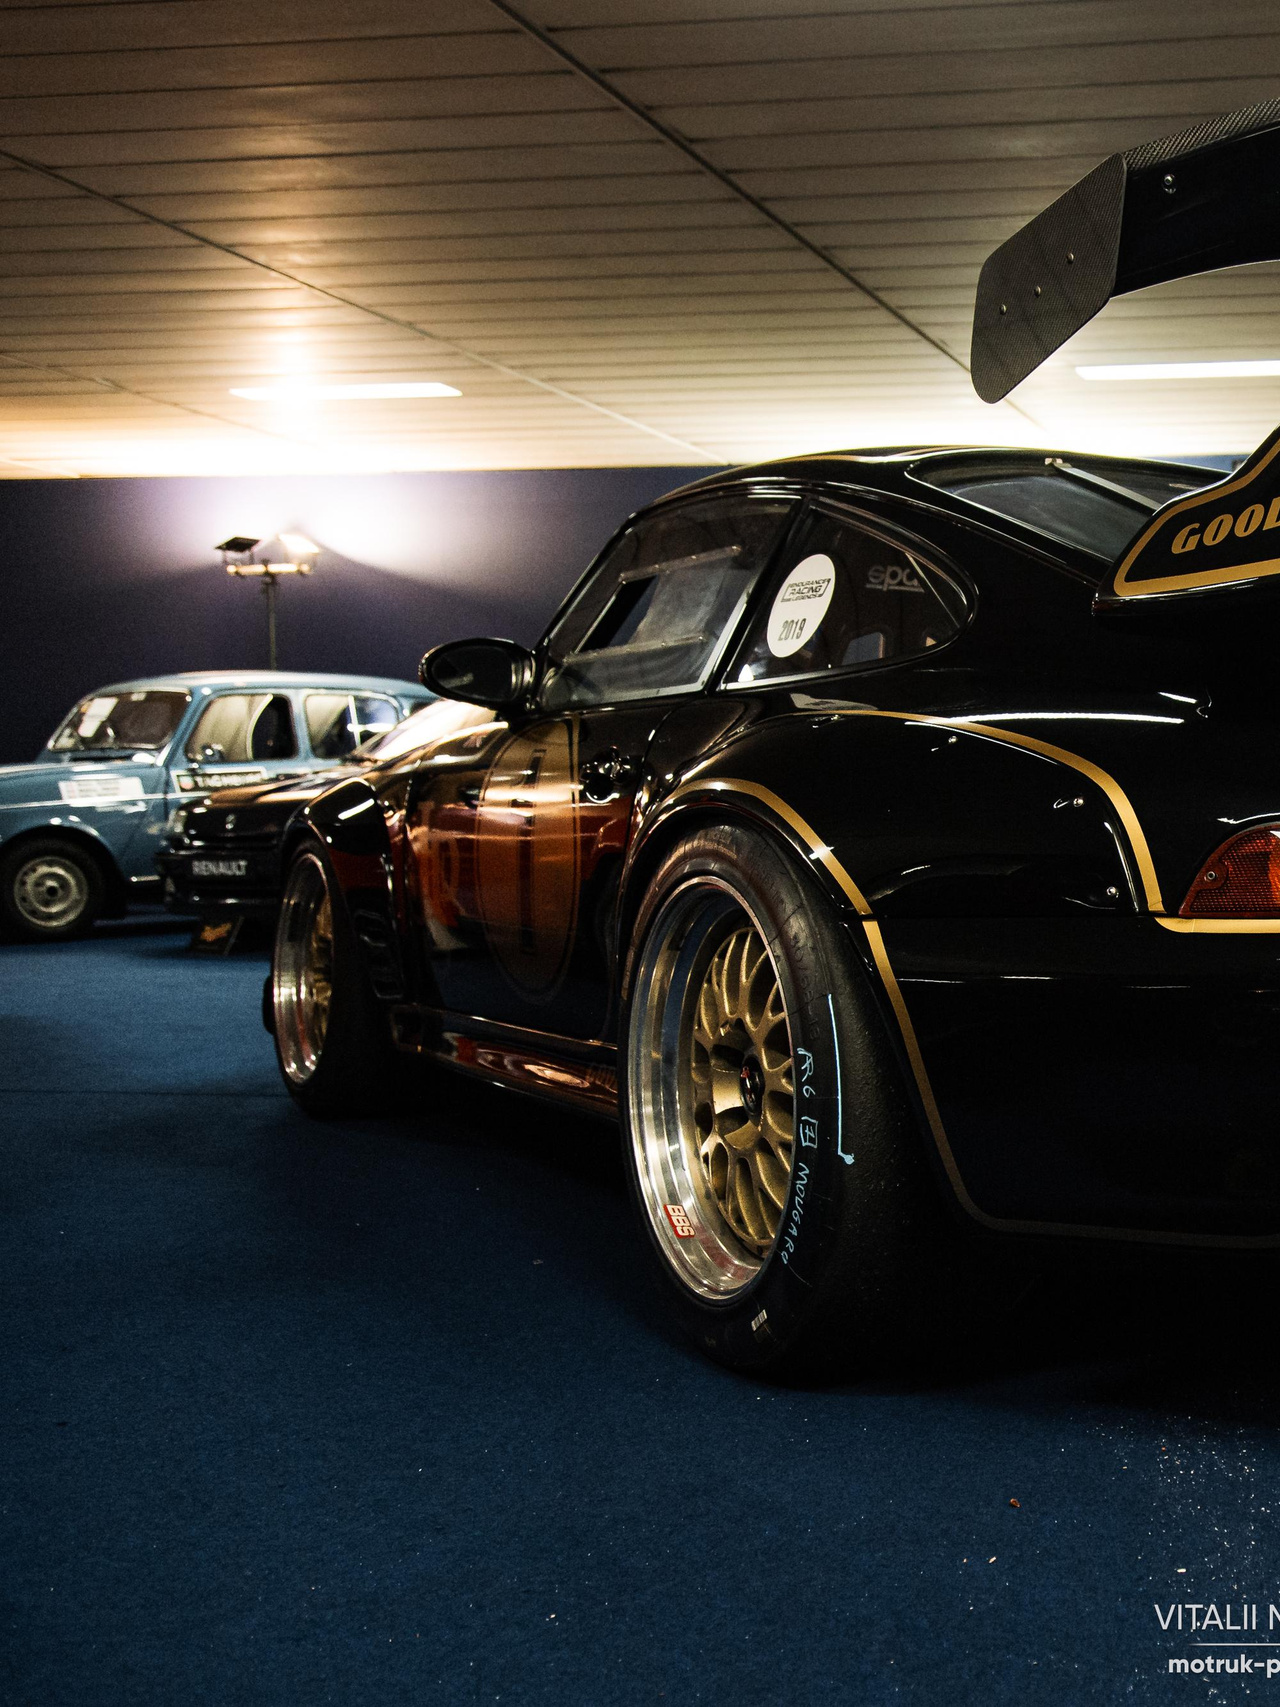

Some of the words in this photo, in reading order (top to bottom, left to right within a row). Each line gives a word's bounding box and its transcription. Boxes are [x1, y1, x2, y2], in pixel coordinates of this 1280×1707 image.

[789, 585, 822, 596] RACING
[778, 618, 806, 641] 2019
[192, 859, 248, 876] RENAULT
[666, 1204, 695, 1236] BBS
